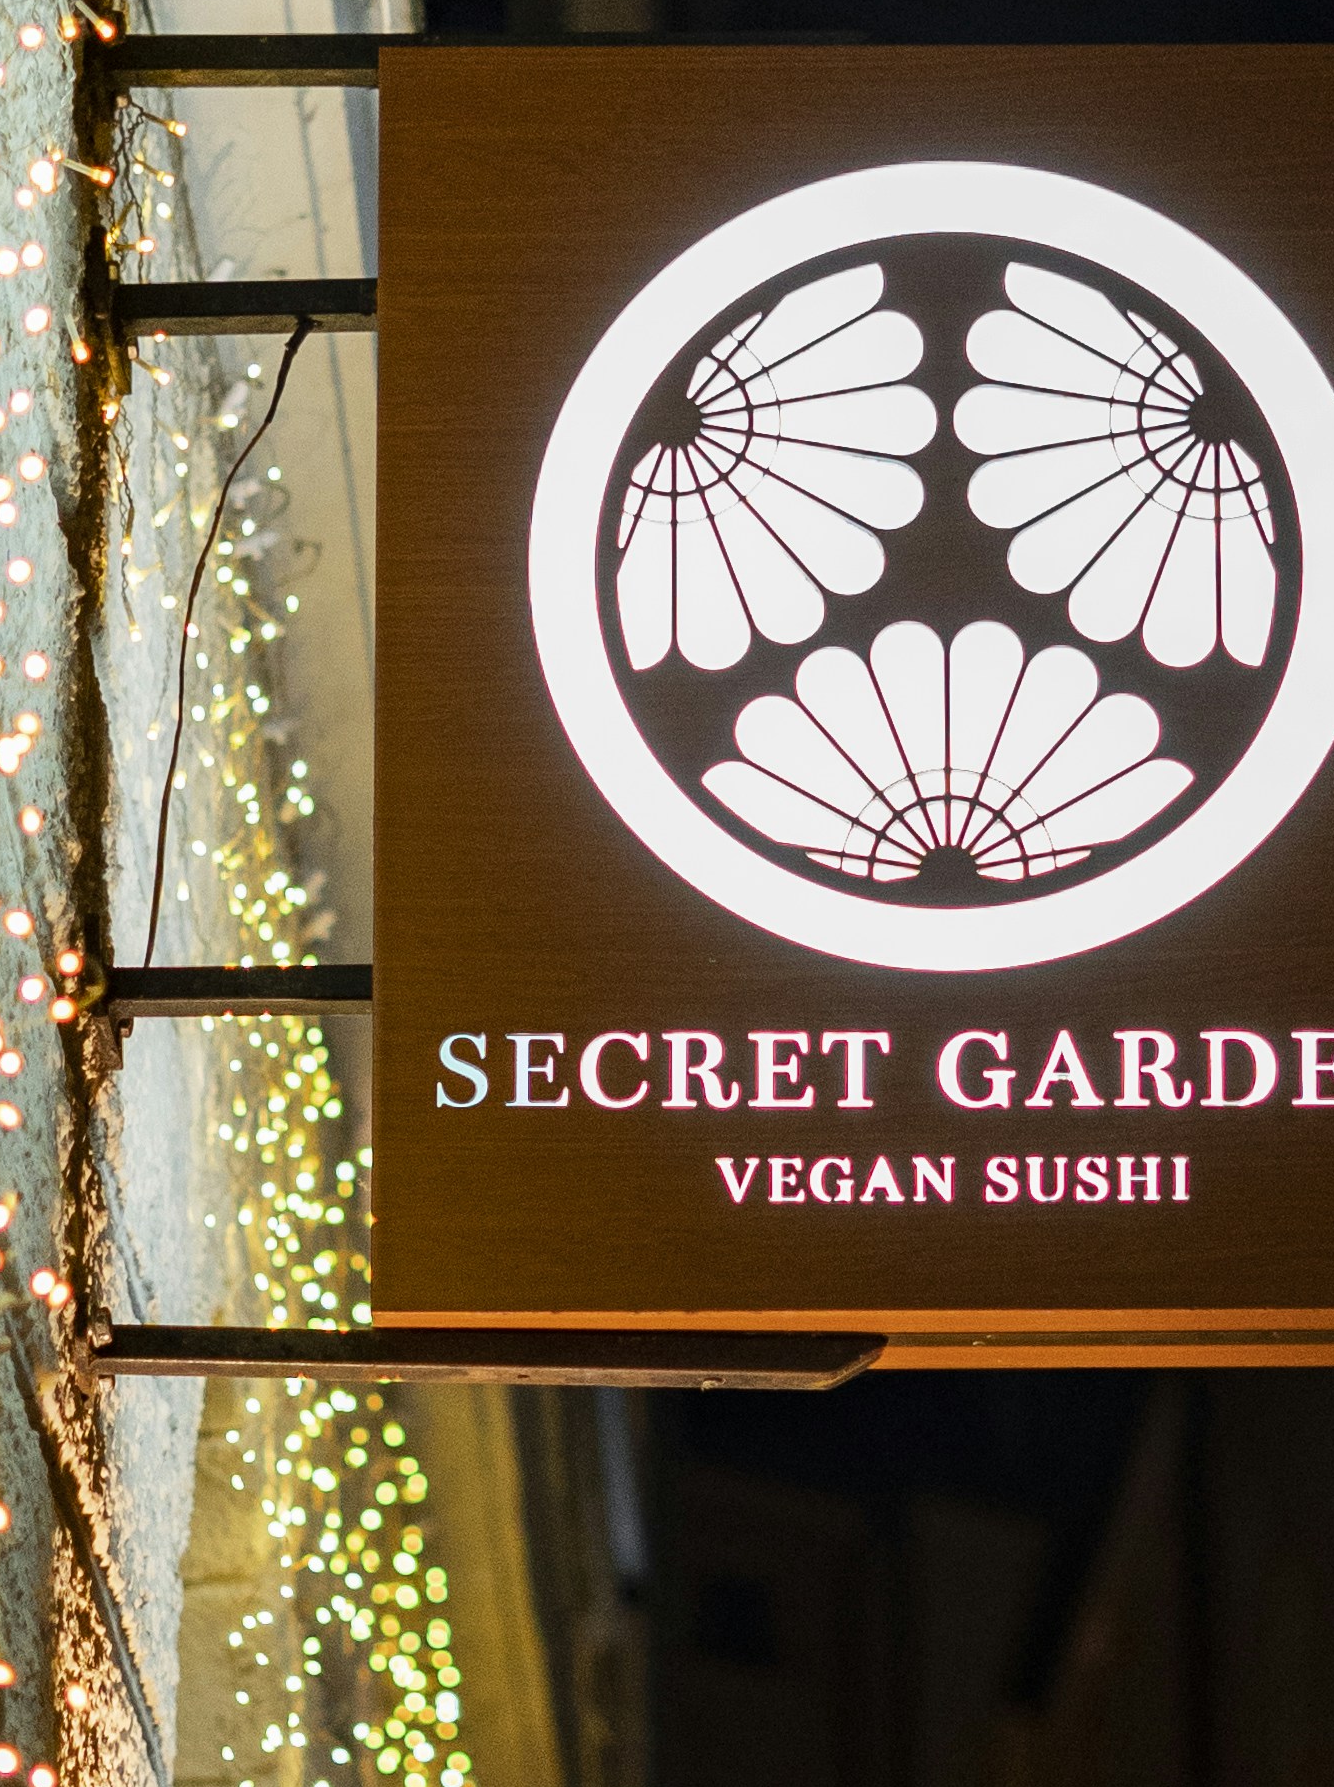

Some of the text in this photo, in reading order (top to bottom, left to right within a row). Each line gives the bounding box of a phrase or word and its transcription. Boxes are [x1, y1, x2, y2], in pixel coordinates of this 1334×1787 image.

[435, 1029, 890, 1109] SECRET
[714, 1155, 1190, 1204] VEGAN SUSHI
